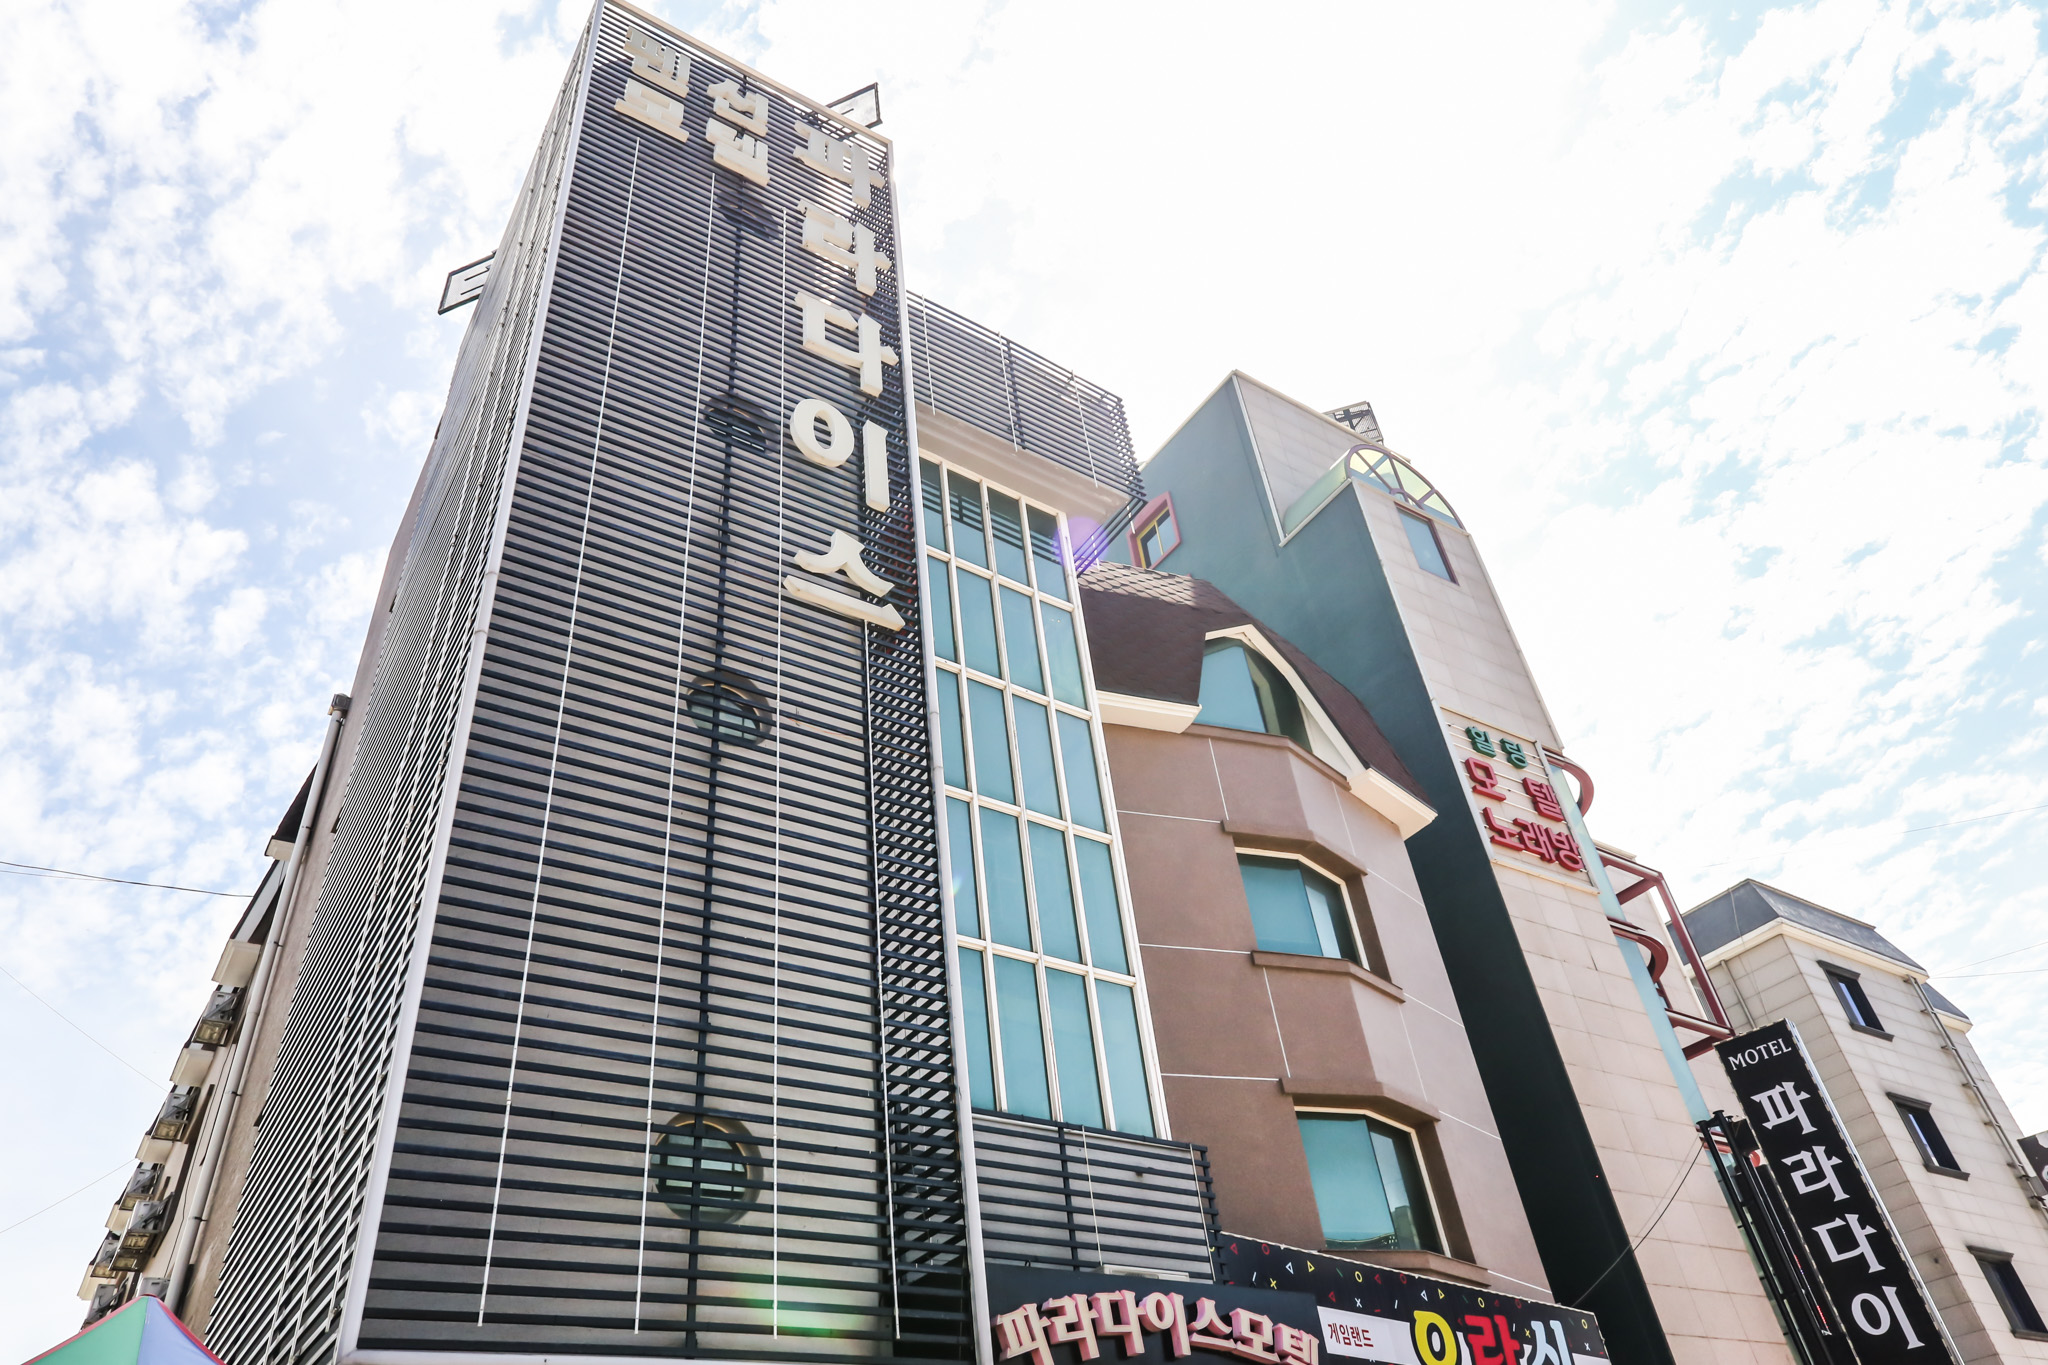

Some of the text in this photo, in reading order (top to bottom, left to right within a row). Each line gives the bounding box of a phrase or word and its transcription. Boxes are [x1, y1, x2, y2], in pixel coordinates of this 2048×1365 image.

[783, 120, 906, 632] 파라다이스
[1465, 726, 1528, 769] 힐링
[1465, 757, 1566, 822] 모텔
[1483, 807, 1586, 872] 노래방
[1727, 1038, 1792, 1071] MOTEL
[1750, 1080, 1925, 1350] 파라다이
[1327, 1322, 1374, 1348] 게임랜드
